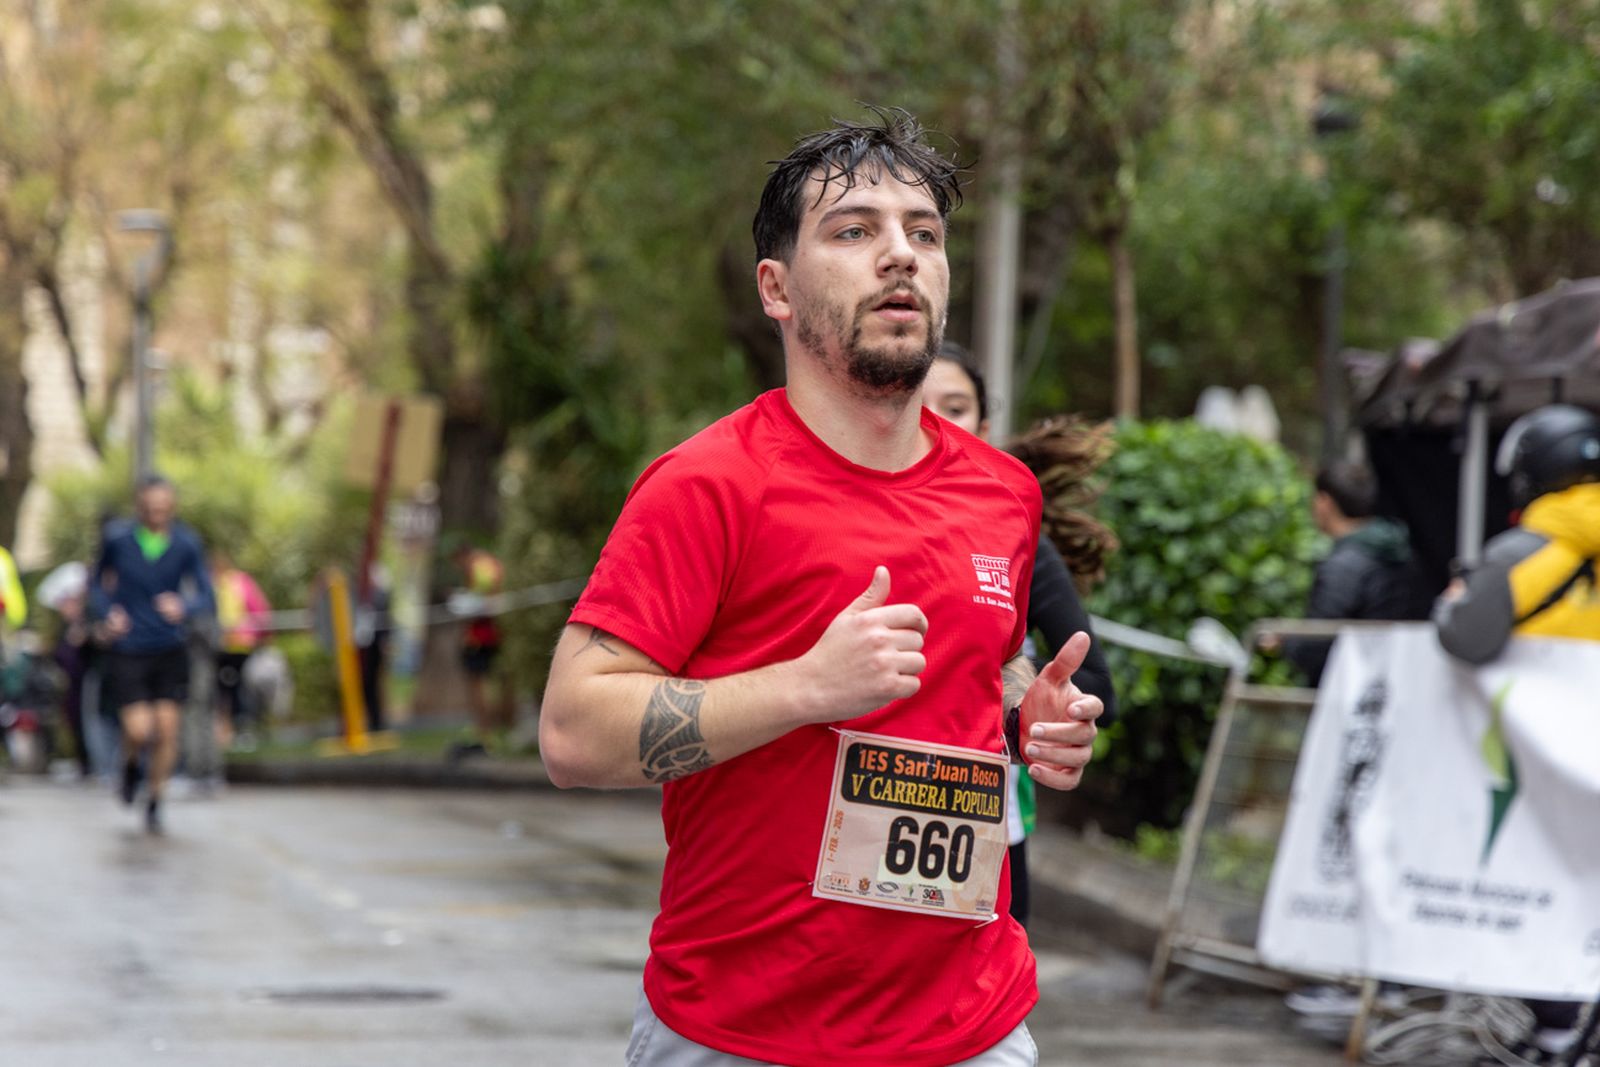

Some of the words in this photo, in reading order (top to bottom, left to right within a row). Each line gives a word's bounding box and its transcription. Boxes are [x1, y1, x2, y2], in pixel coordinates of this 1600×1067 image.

[894, 754, 928, 778] San
[932, 759, 969, 783] Juan
[971, 764, 999, 788] Bosco
[869, 776, 947, 809] CARRERA
[951, 788, 1000, 818] POPULAR
[885, 815, 975, 883] 660
